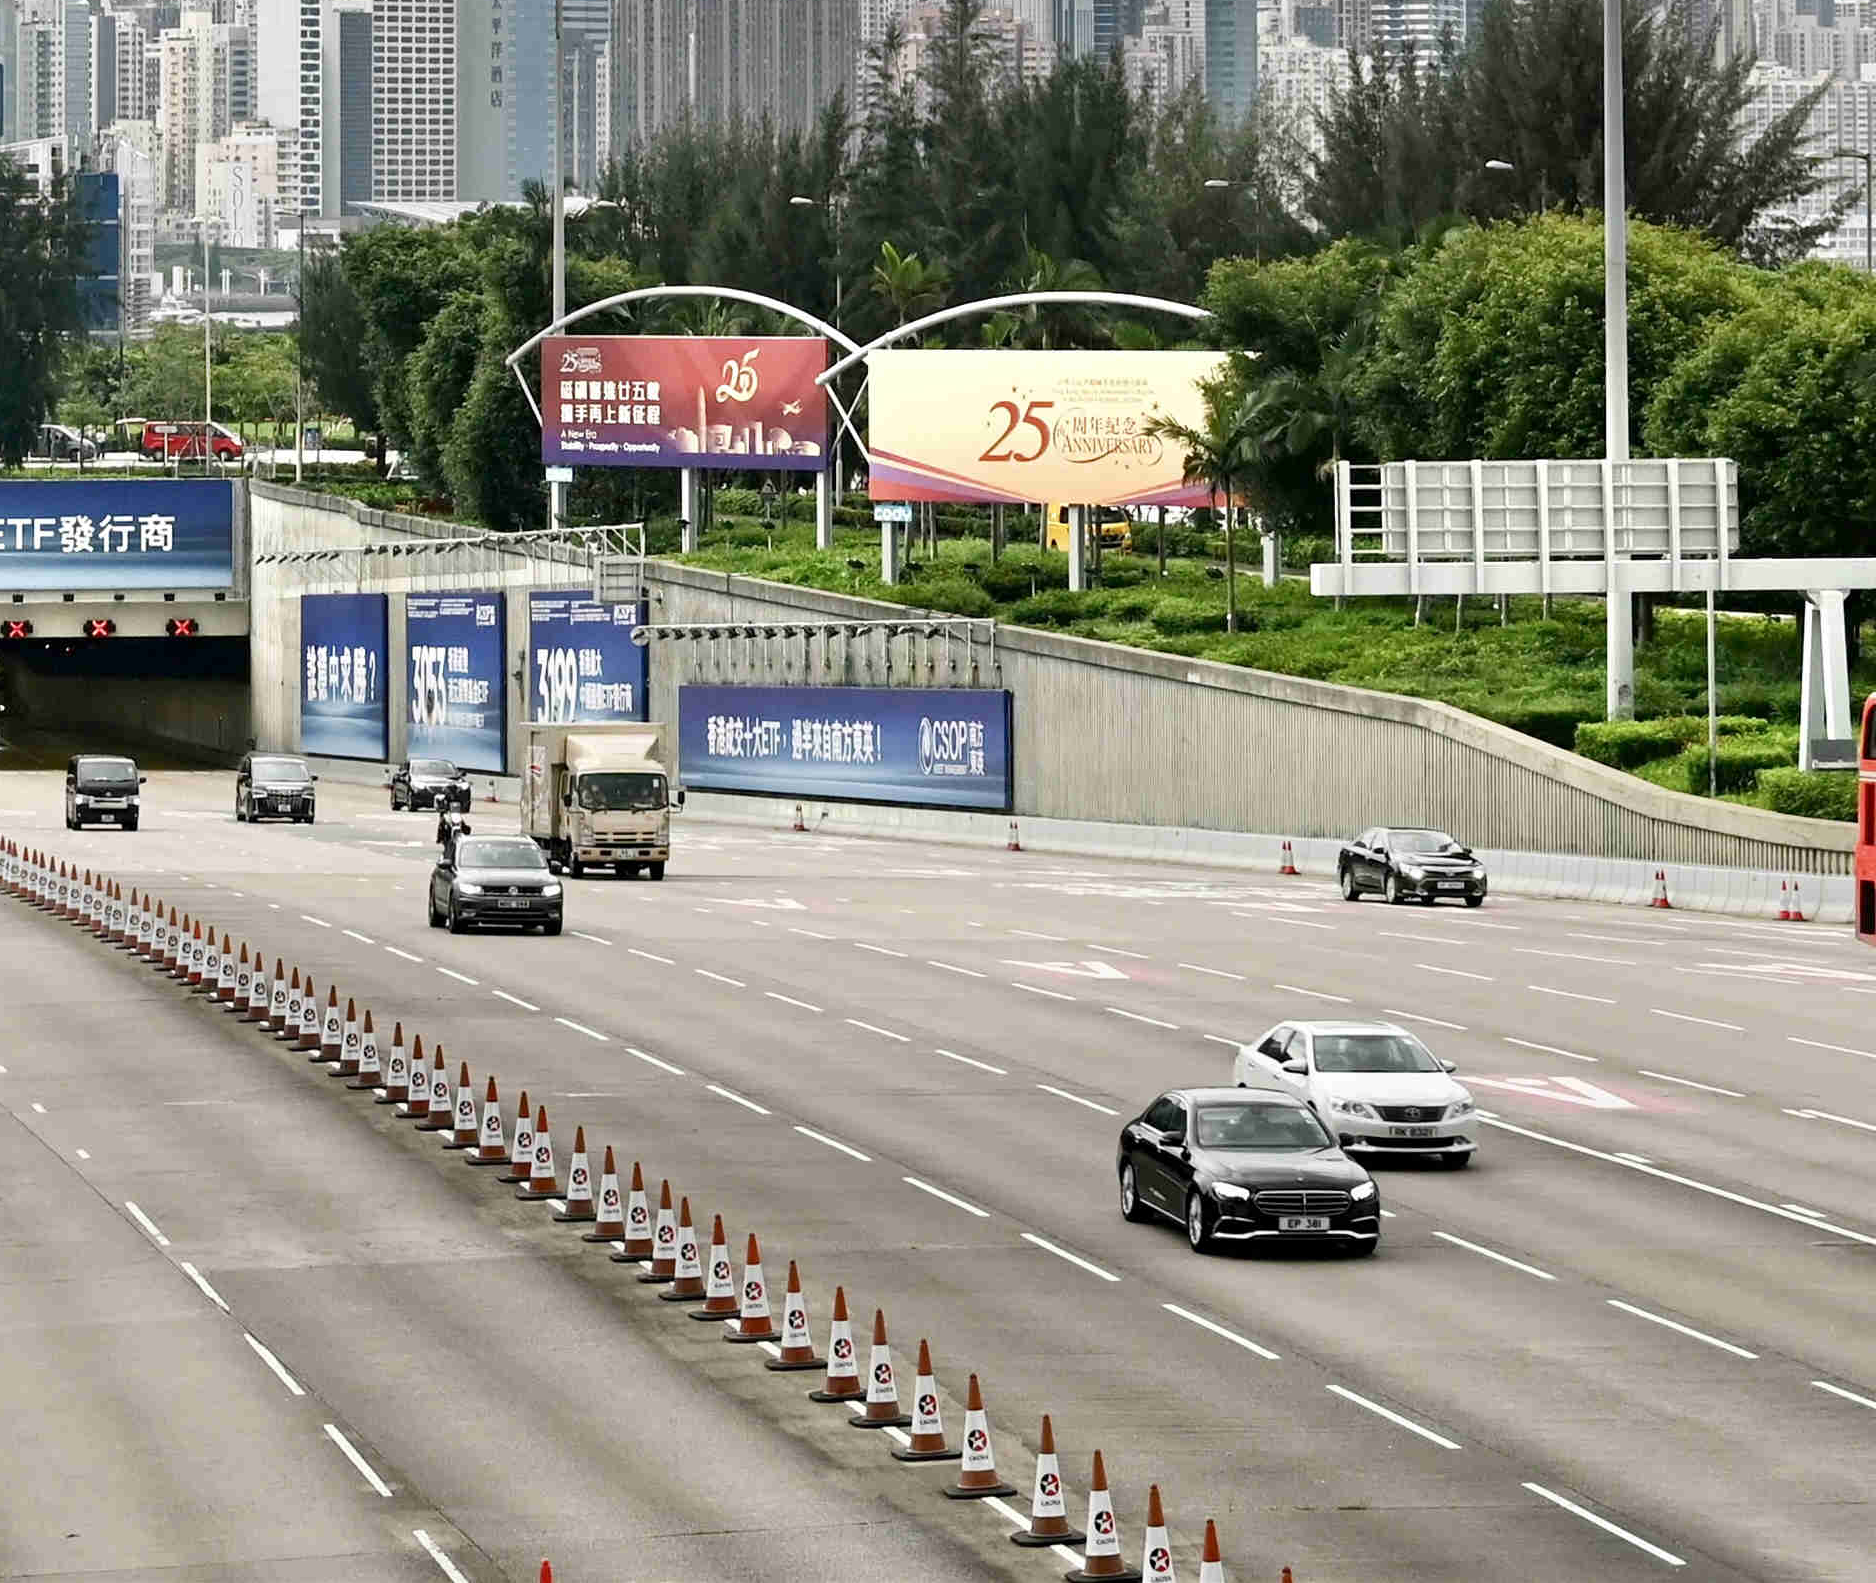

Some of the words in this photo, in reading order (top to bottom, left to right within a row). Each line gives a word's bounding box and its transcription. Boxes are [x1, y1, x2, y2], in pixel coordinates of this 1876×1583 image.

[979, 401, 1055, 462] 25
[1062, 433, 1155, 455] ANNIVERSARY
[412, 645, 447, 724] 3053
[933, 720, 968, 761] CSOP
